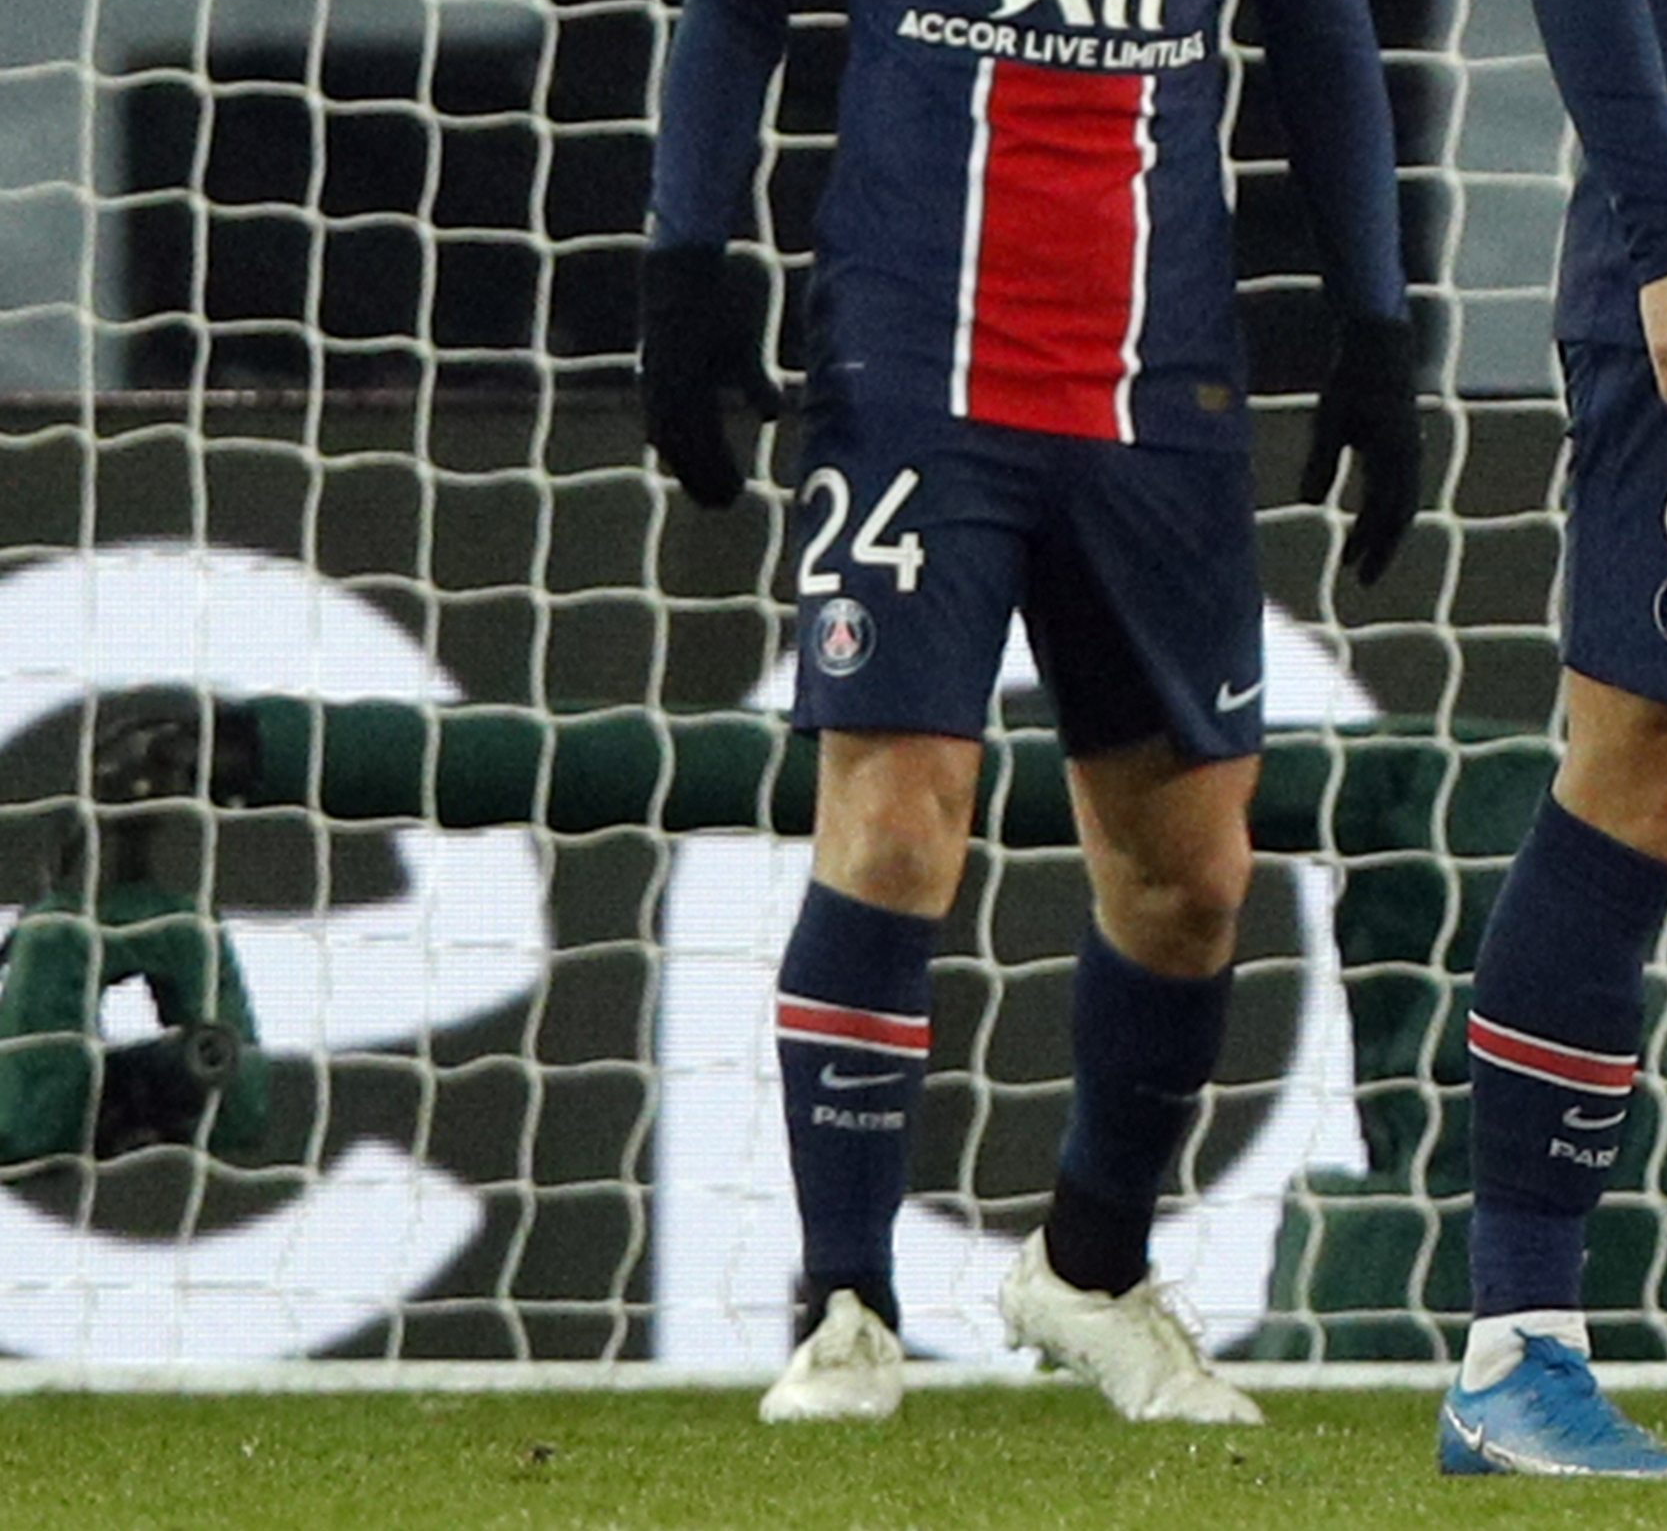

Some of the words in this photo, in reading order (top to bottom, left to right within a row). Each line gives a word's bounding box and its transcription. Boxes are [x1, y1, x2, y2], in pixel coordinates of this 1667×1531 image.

[896, 9, 1017, 57] ACCOR
[1024, 30, 1099, 66] LIVE
[798, 466, 924, 595] 24
[1549, 1138, 1618, 1168] PAR
